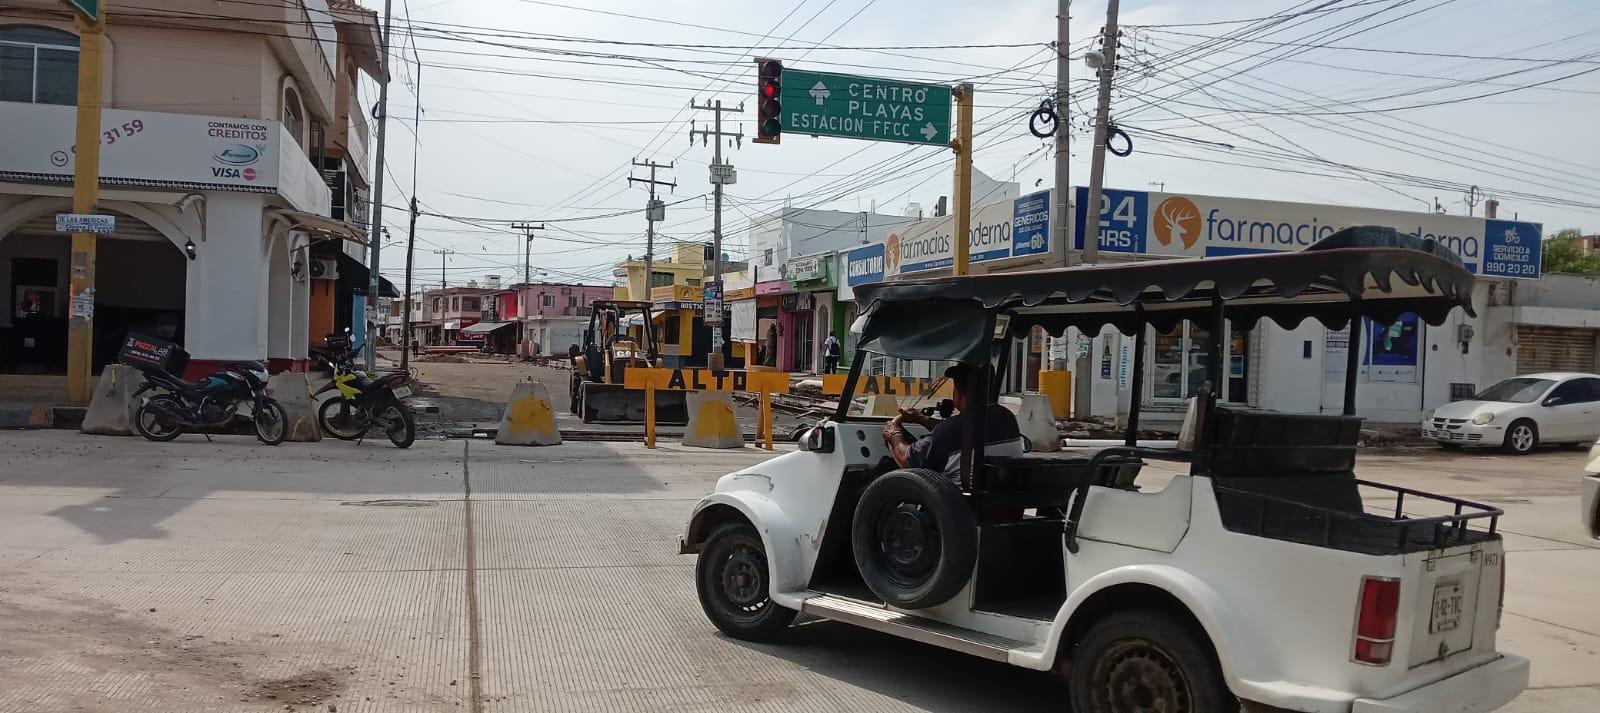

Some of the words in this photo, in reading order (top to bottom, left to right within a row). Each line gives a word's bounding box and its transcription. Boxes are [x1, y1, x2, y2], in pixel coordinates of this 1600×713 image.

[849, 83, 926, 103] CENTRO
[848, 101, 924, 121] PLAYAS
[122, 119, 144, 136] 59
[208, 121, 250, 131] CONTAMOS
[250, 124, 267, 132] CON
[208, 128, 267, 141] CREDITOS
[791, 113, 864, 133] ESTACION
[873, 121, 910, 137] FFCC
[210, 166, 241, 178] VISA
[1206, 208, 1345, 247] farmaci
[899, 231, 950, 260] farmacias
[968, 220, 1010, 248] oderna
[1492, 244, 1524, 254] SERVICIO
[849, 255, 883, 278] CONSULTORIO
[1486, 261, 1505, 273] 990
[1507, 263, 1520, 274] 20
[1522, 264, 1535, 275] 20
[668, 367, 747, 390] ALTO
[863, 376, 932, 396] ALTO
